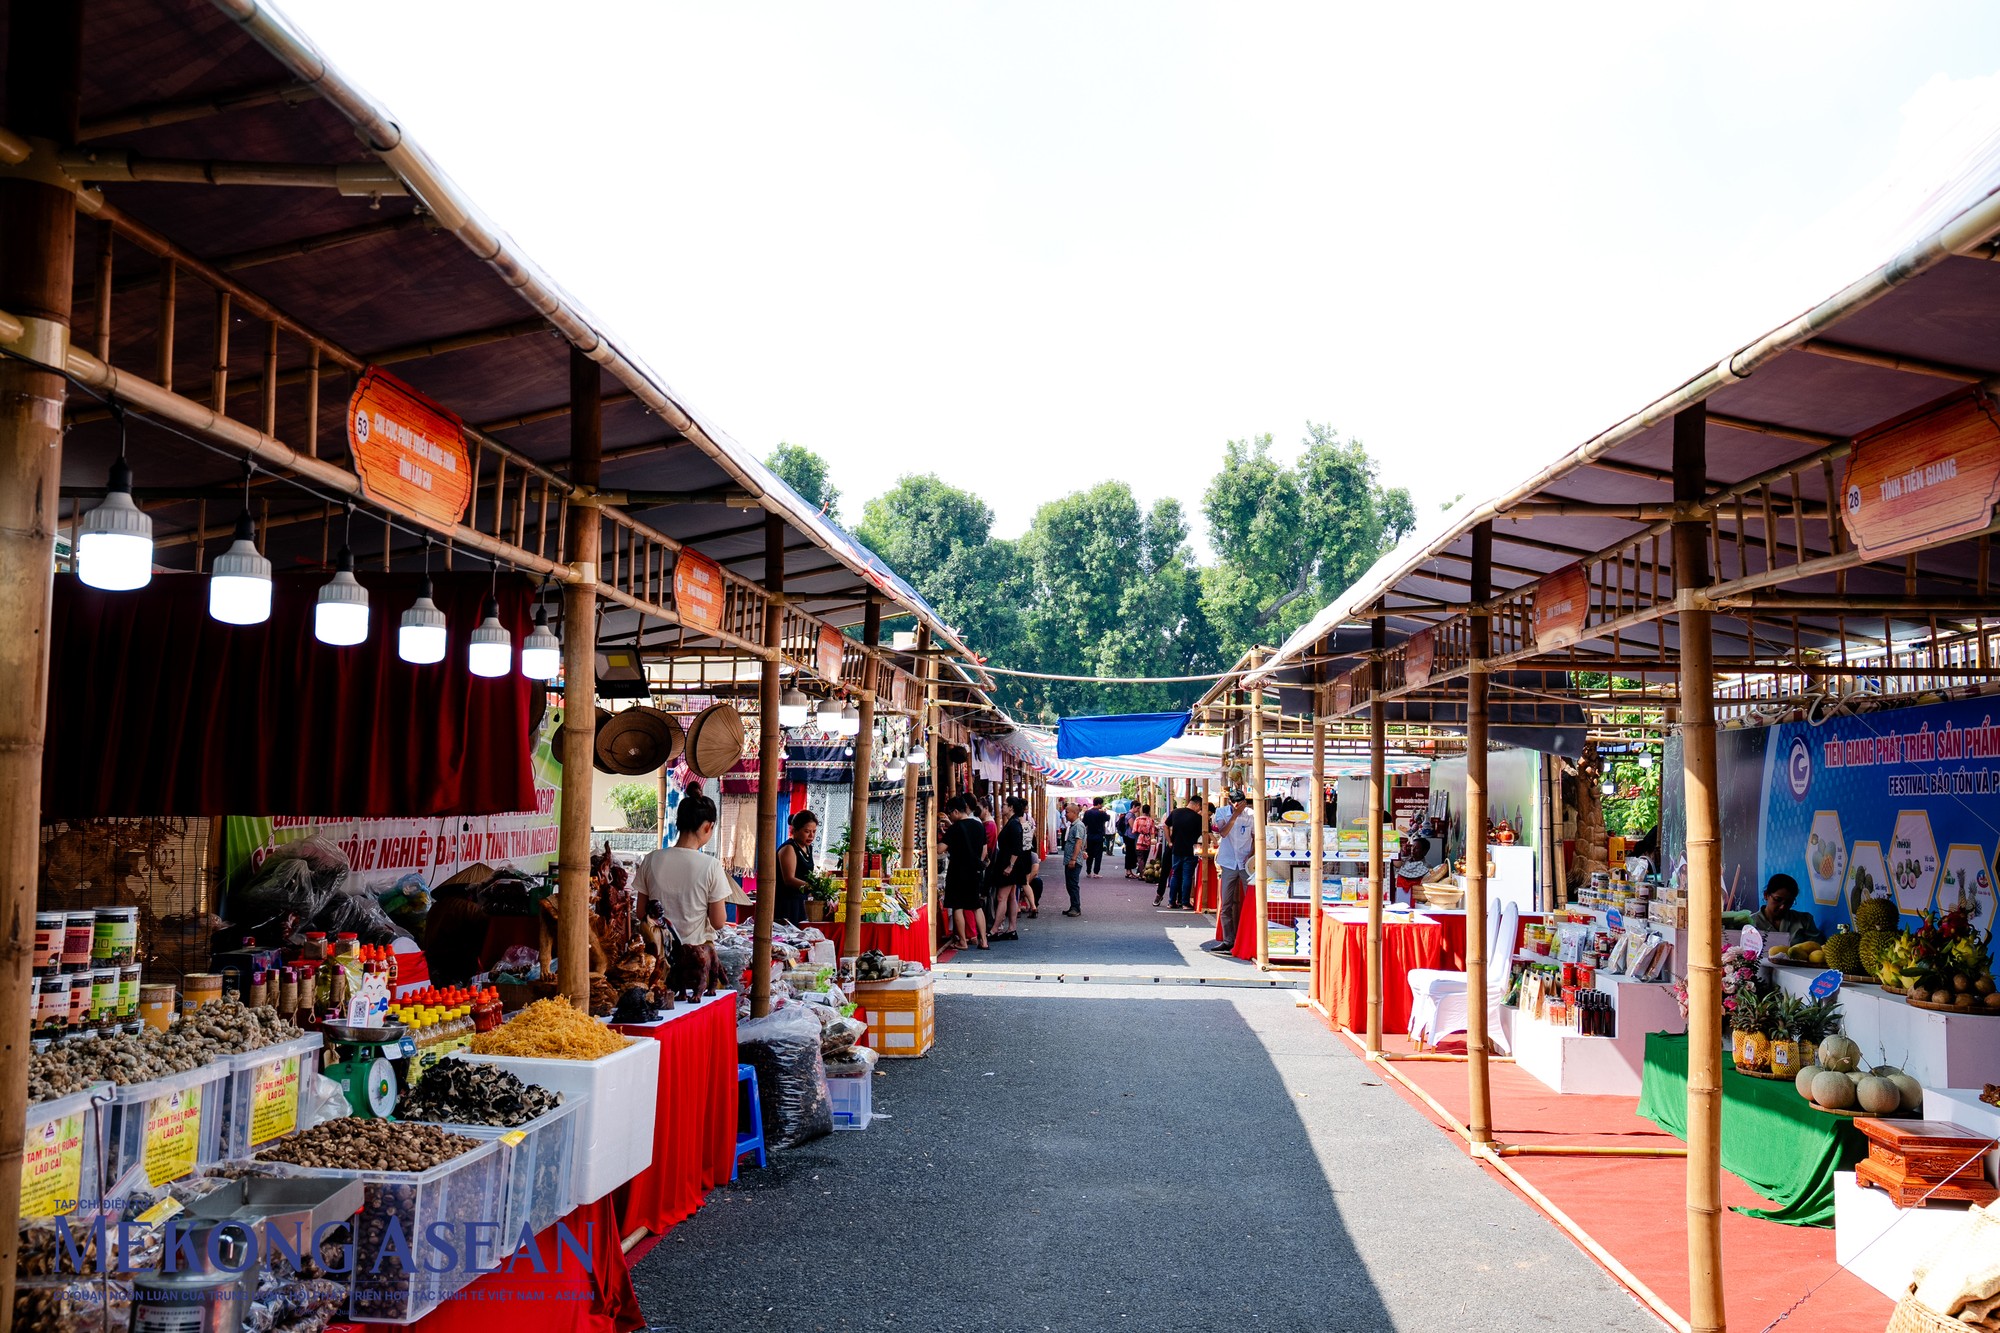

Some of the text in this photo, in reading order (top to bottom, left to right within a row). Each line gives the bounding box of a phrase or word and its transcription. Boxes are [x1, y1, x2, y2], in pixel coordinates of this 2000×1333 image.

[357, 417, 367, 437] 53
[1880, 475, 1901, 502] TỈNH
[1926, 458, 1958, 486] GIANG
[1848, 491, 1860, 509] 28
[1845, 737, 1874, 767] GIANG
[1875, 729, 1902, 764] PHÁT
[1903, 721, 1936, 762] TRIỂN
[1937, 720, 1962, 760] SẢN
[1964, 713, 2000, 758] PHẨM
[1888, 774, 1929, 796] FESTIVAL
[1930, 767, 1950, 795] BẢO
[1952, 765, 1973, 794] TỒN
[1975, 766, 1990, 794] VÀ
[377, 829, 433, 875] NGHIỆP
[459, 824, 483, 863] SẢN
[485, 823, 509, 860] TỈNH
[510, 823, 530, 858] THÁI
[530, 820, 559, 854] NGUYÊN
[278, 1088, 286, 1099] CAI
[175, 1124, 184, 1135] CAI
[50, 1157, 62, 1169] CAI
